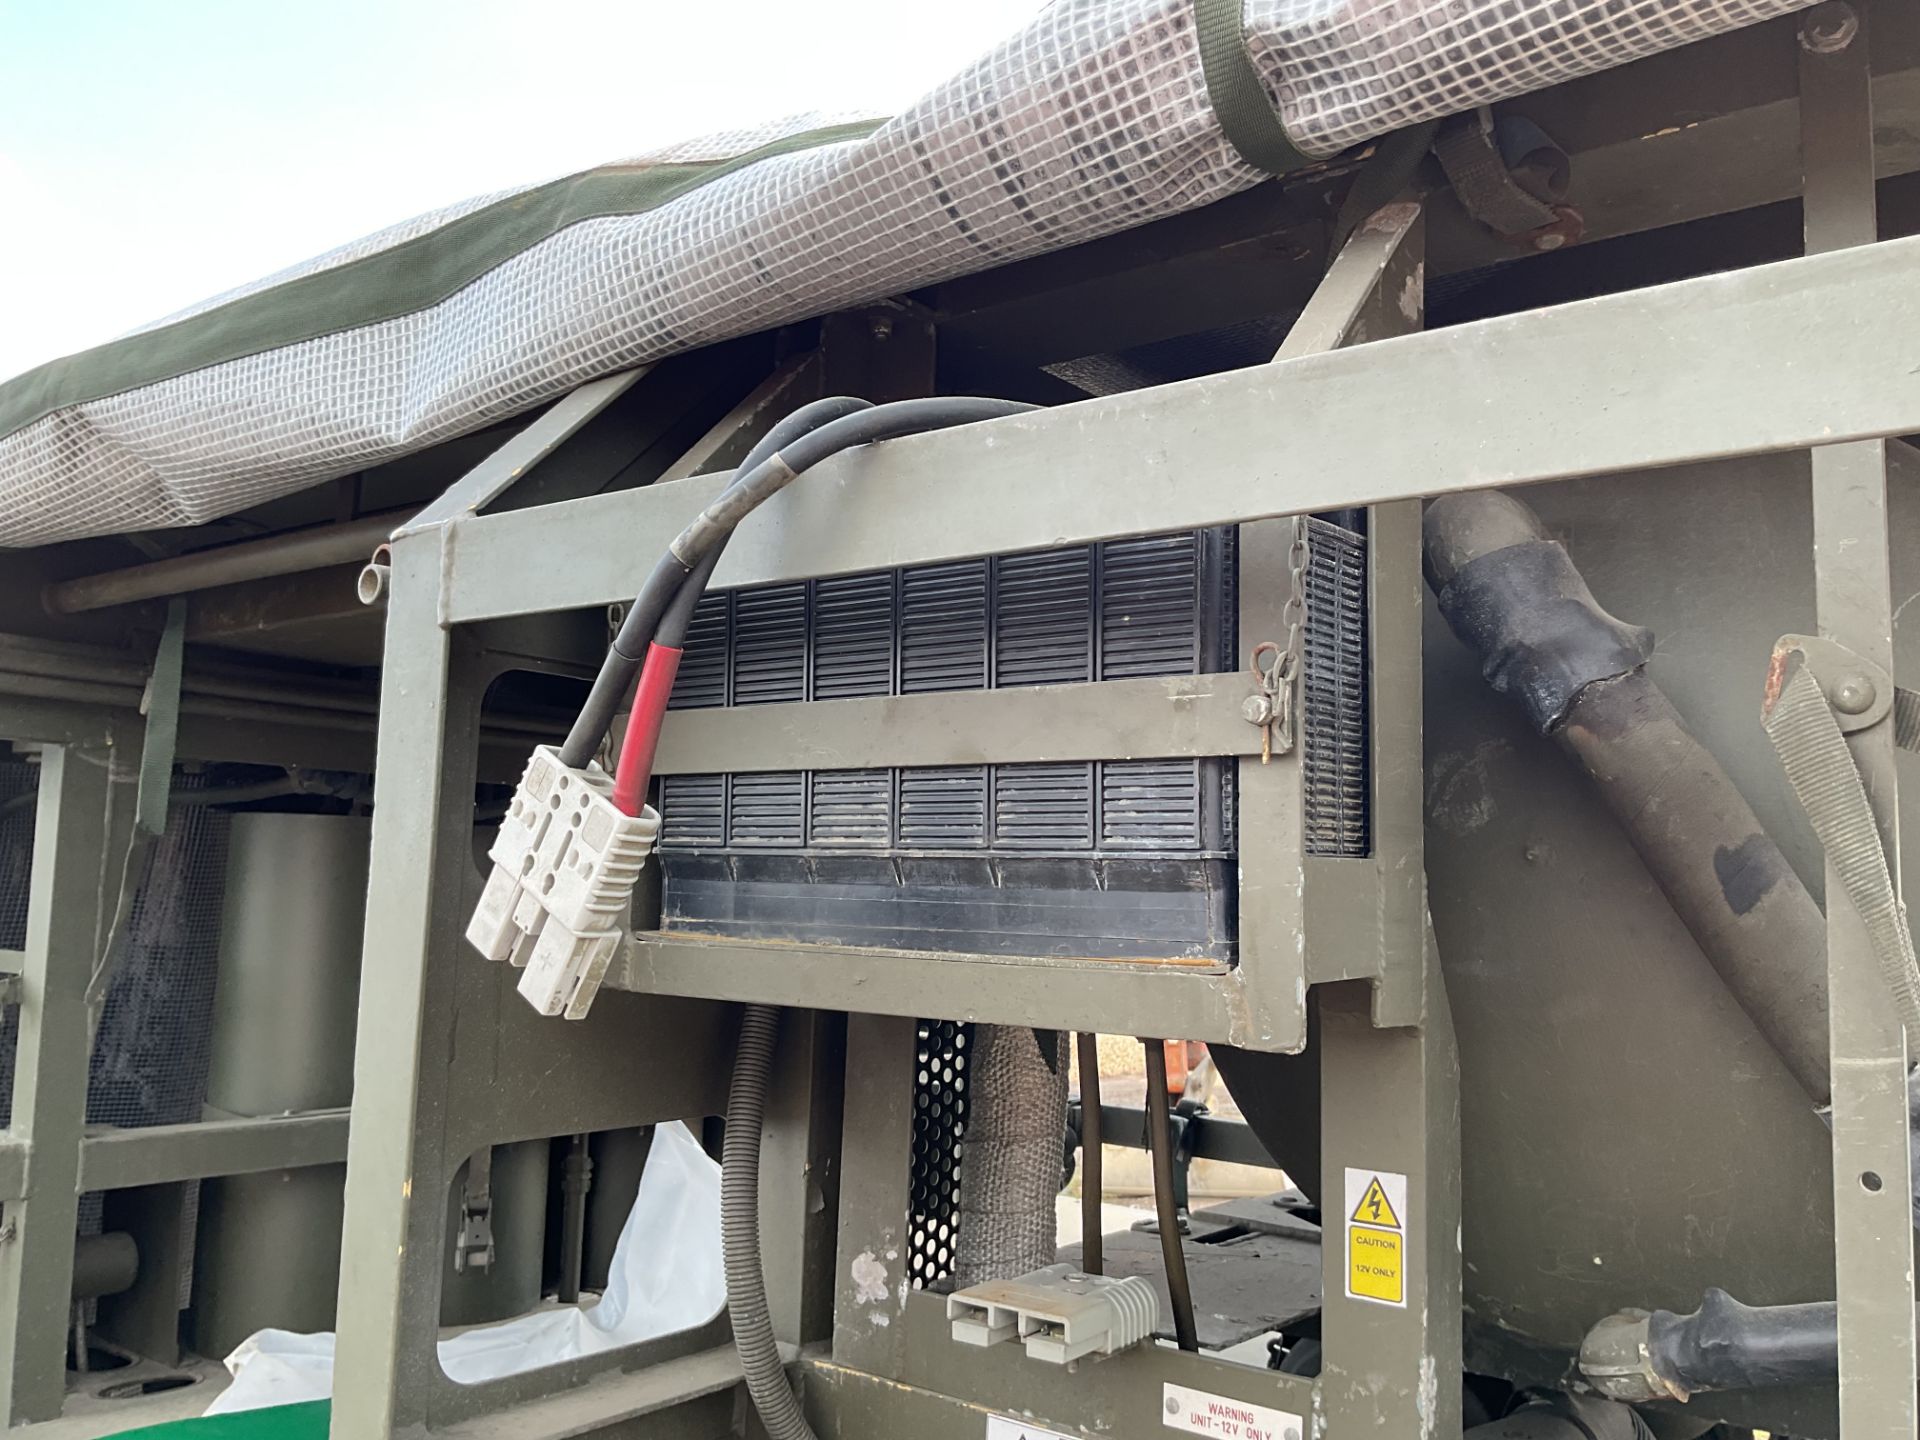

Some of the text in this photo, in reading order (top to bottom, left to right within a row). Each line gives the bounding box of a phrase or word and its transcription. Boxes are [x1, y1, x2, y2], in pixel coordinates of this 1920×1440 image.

[1356, 1236, 1396, 1249] CAUTION
[1355, 1264, 1396, 1278] 12V ONLY
[1208, 1402, 1254, 1425] WARNING
